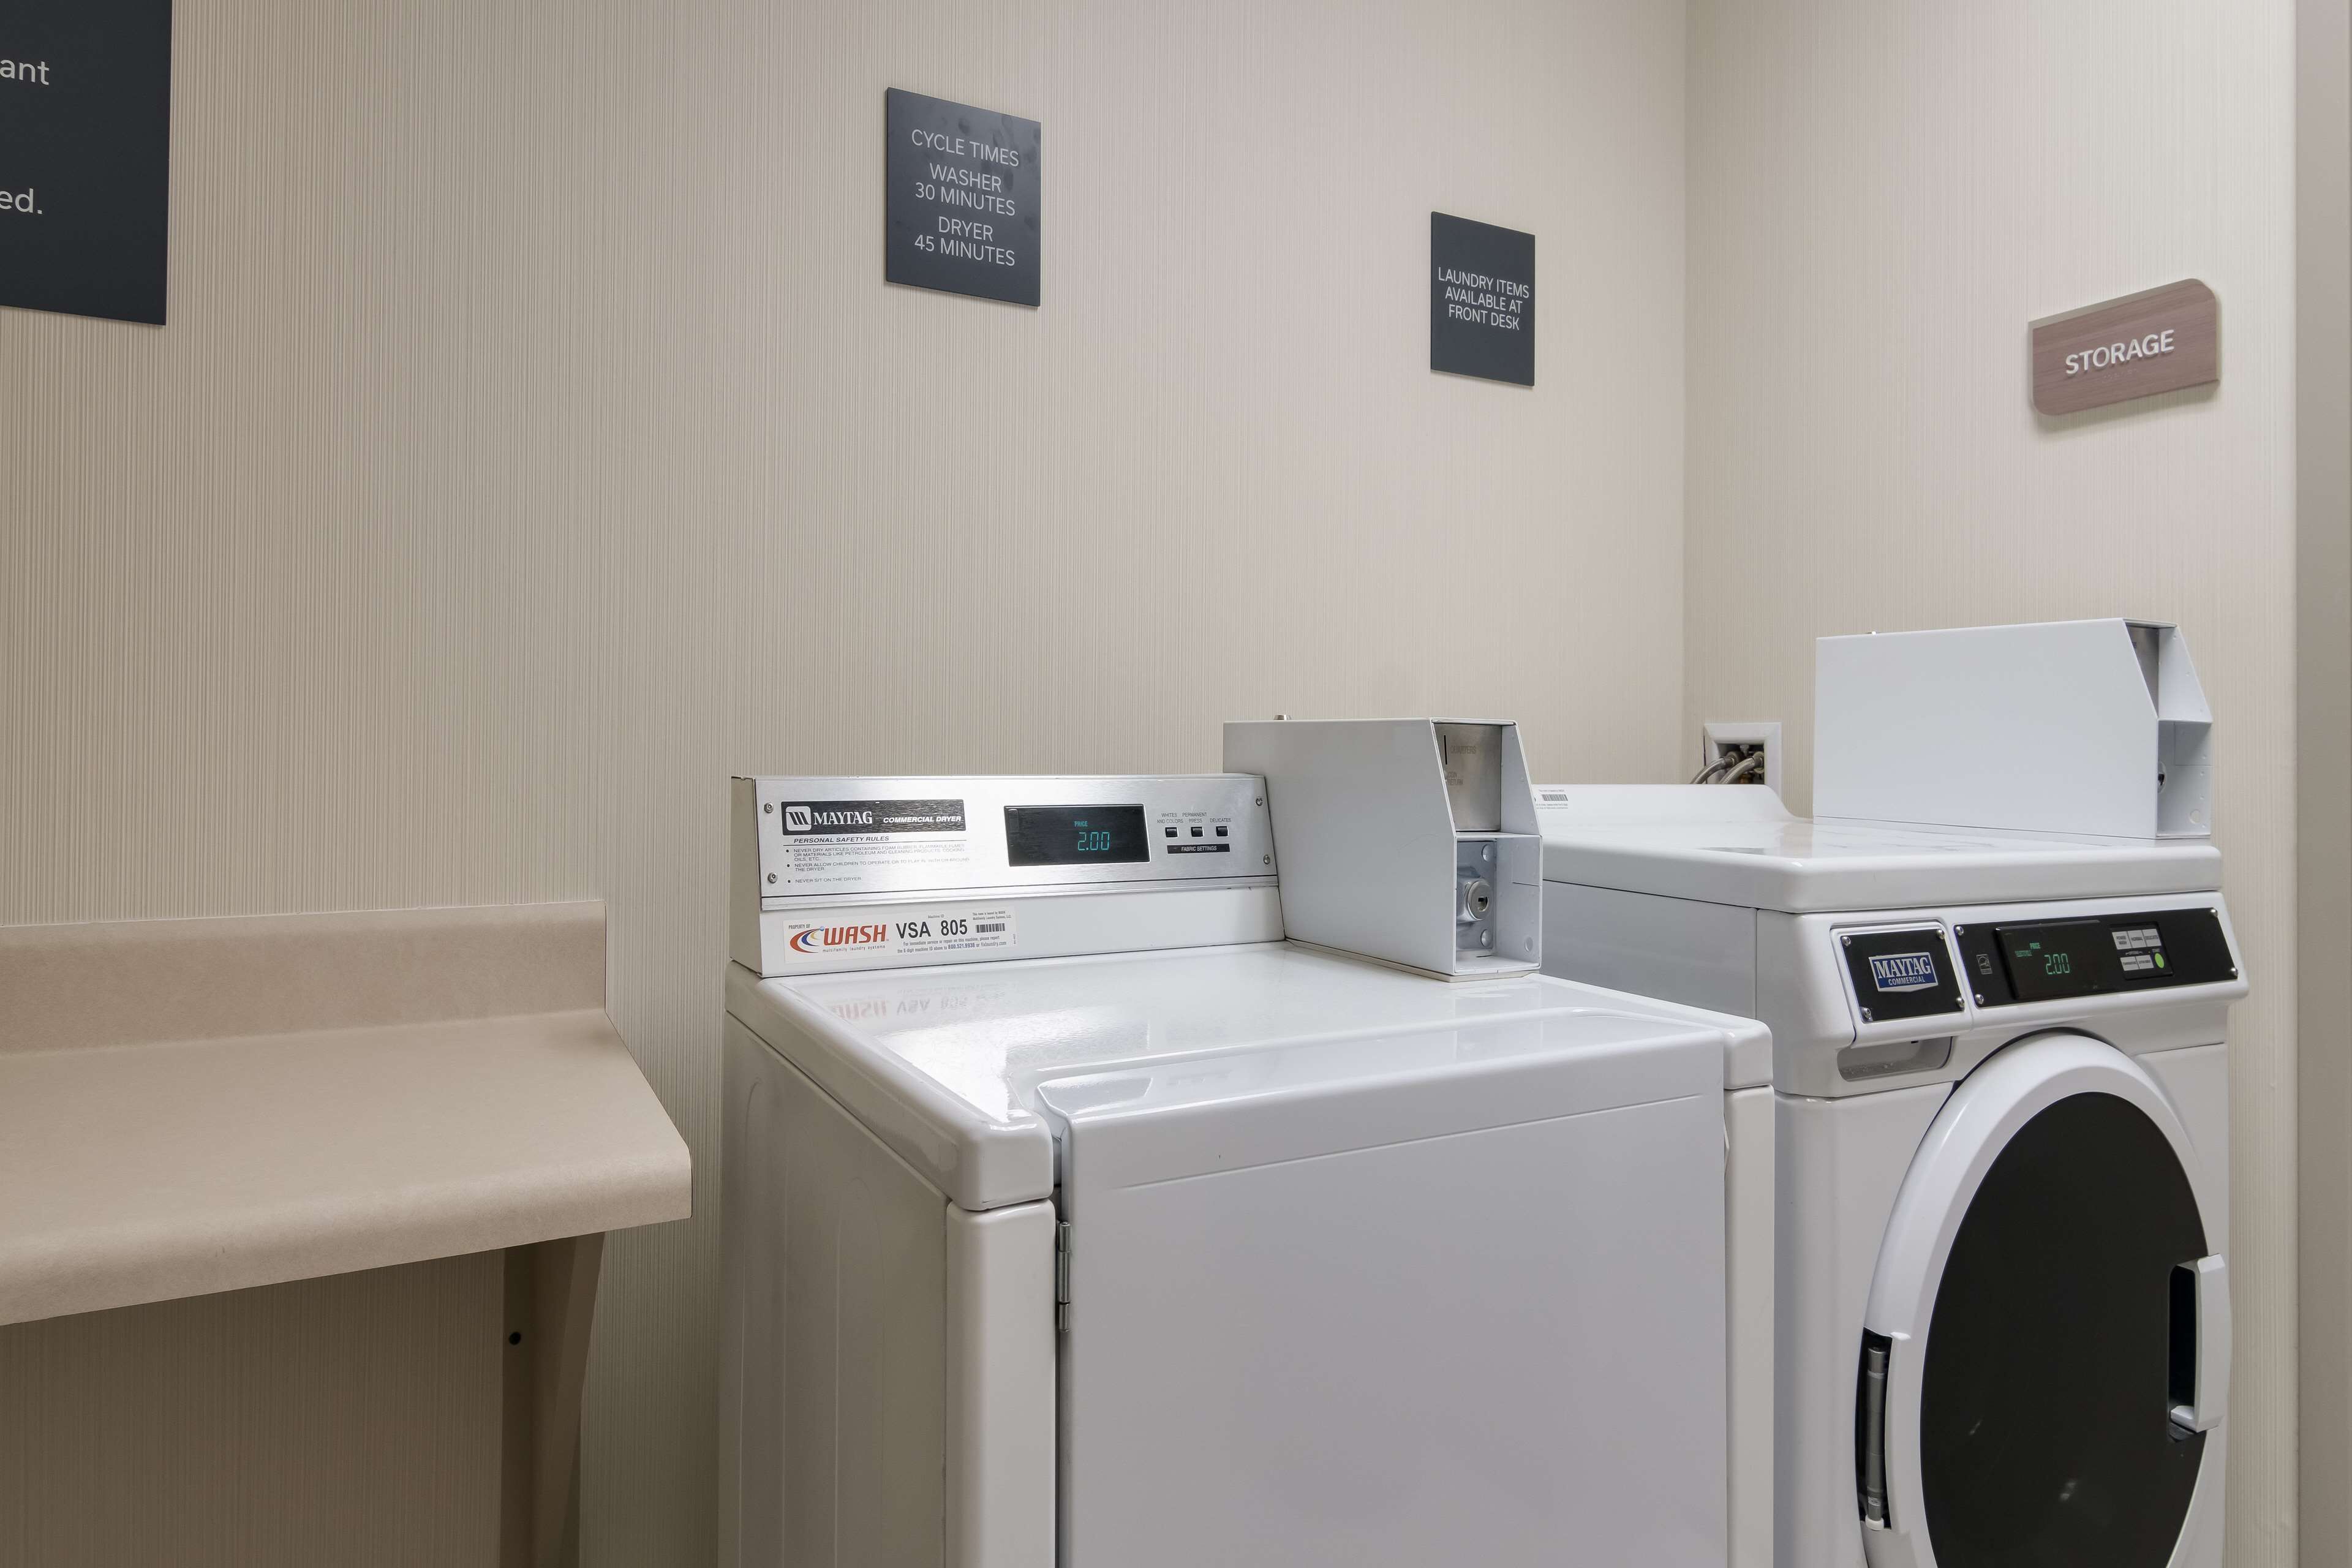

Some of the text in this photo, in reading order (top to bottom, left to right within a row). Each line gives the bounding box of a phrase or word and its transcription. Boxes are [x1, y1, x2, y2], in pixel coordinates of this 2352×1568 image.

[911, 129, 1019, 167] CYCLE TIMES
[930, 162, 1001, 193] WASHER
[915, 182, 1015, 216] 30 MINUTES
[938, 216, 993, 242] DRYER
[914, 235, 1015, 266] 45 MINUTES
[1438, 267, 1529, 298] LAUNDRY ITEMS
[1445, 286, 1523, 314] AVAILABLE AT
[1449, 304, 1519, 330] FRONT DESK
[2065, 330, 2174, 374] STORAGE
[813, 811, 872, 825] MAYTAG
[1078, 832, 1110, 851] 2.00
[823, 924, 887, 946] WASH
[895, 919, 968, 939] VSA 805
[1874, 957, 1931, 979] MAYTAG
[2044, 953, 2070, 974] 2.00
[1888, 976, 1926, 986] COMMERCIAL
